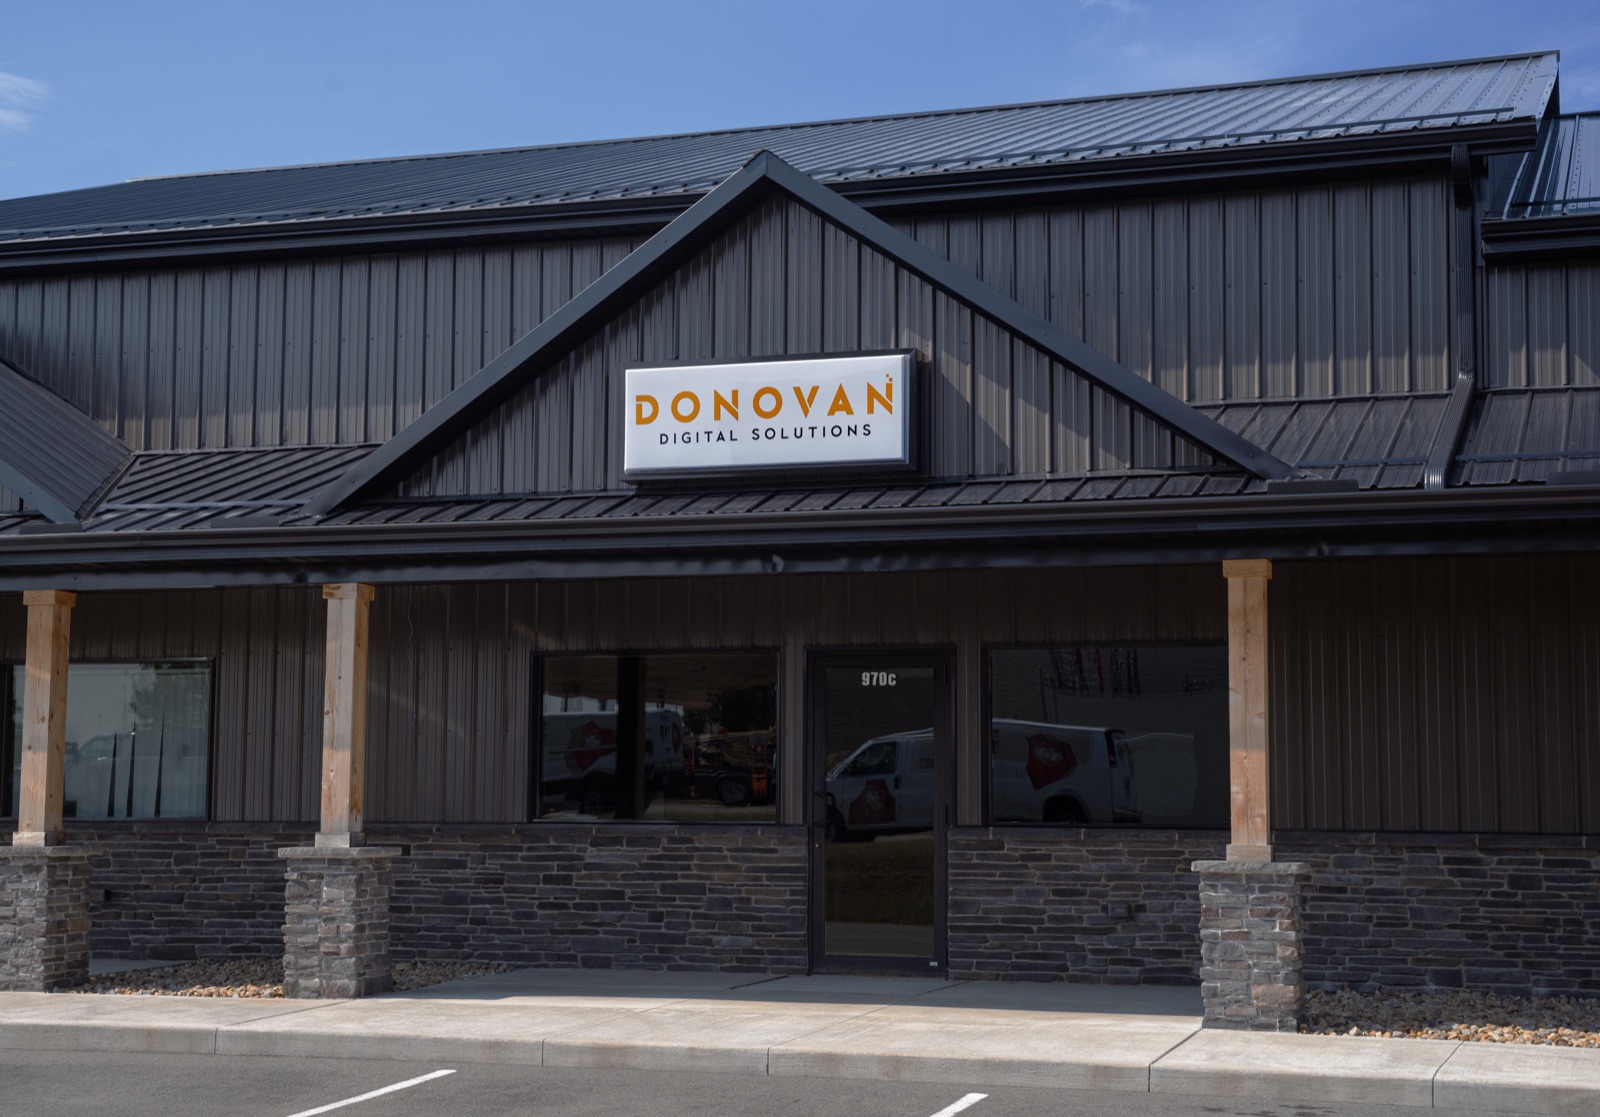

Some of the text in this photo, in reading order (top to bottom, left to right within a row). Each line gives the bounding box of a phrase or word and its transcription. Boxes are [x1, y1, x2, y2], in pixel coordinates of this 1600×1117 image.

[635, 374, 893, 426] DONOVAN
[659, 423, 872, 445] DIGITAL SOLUTIONS
